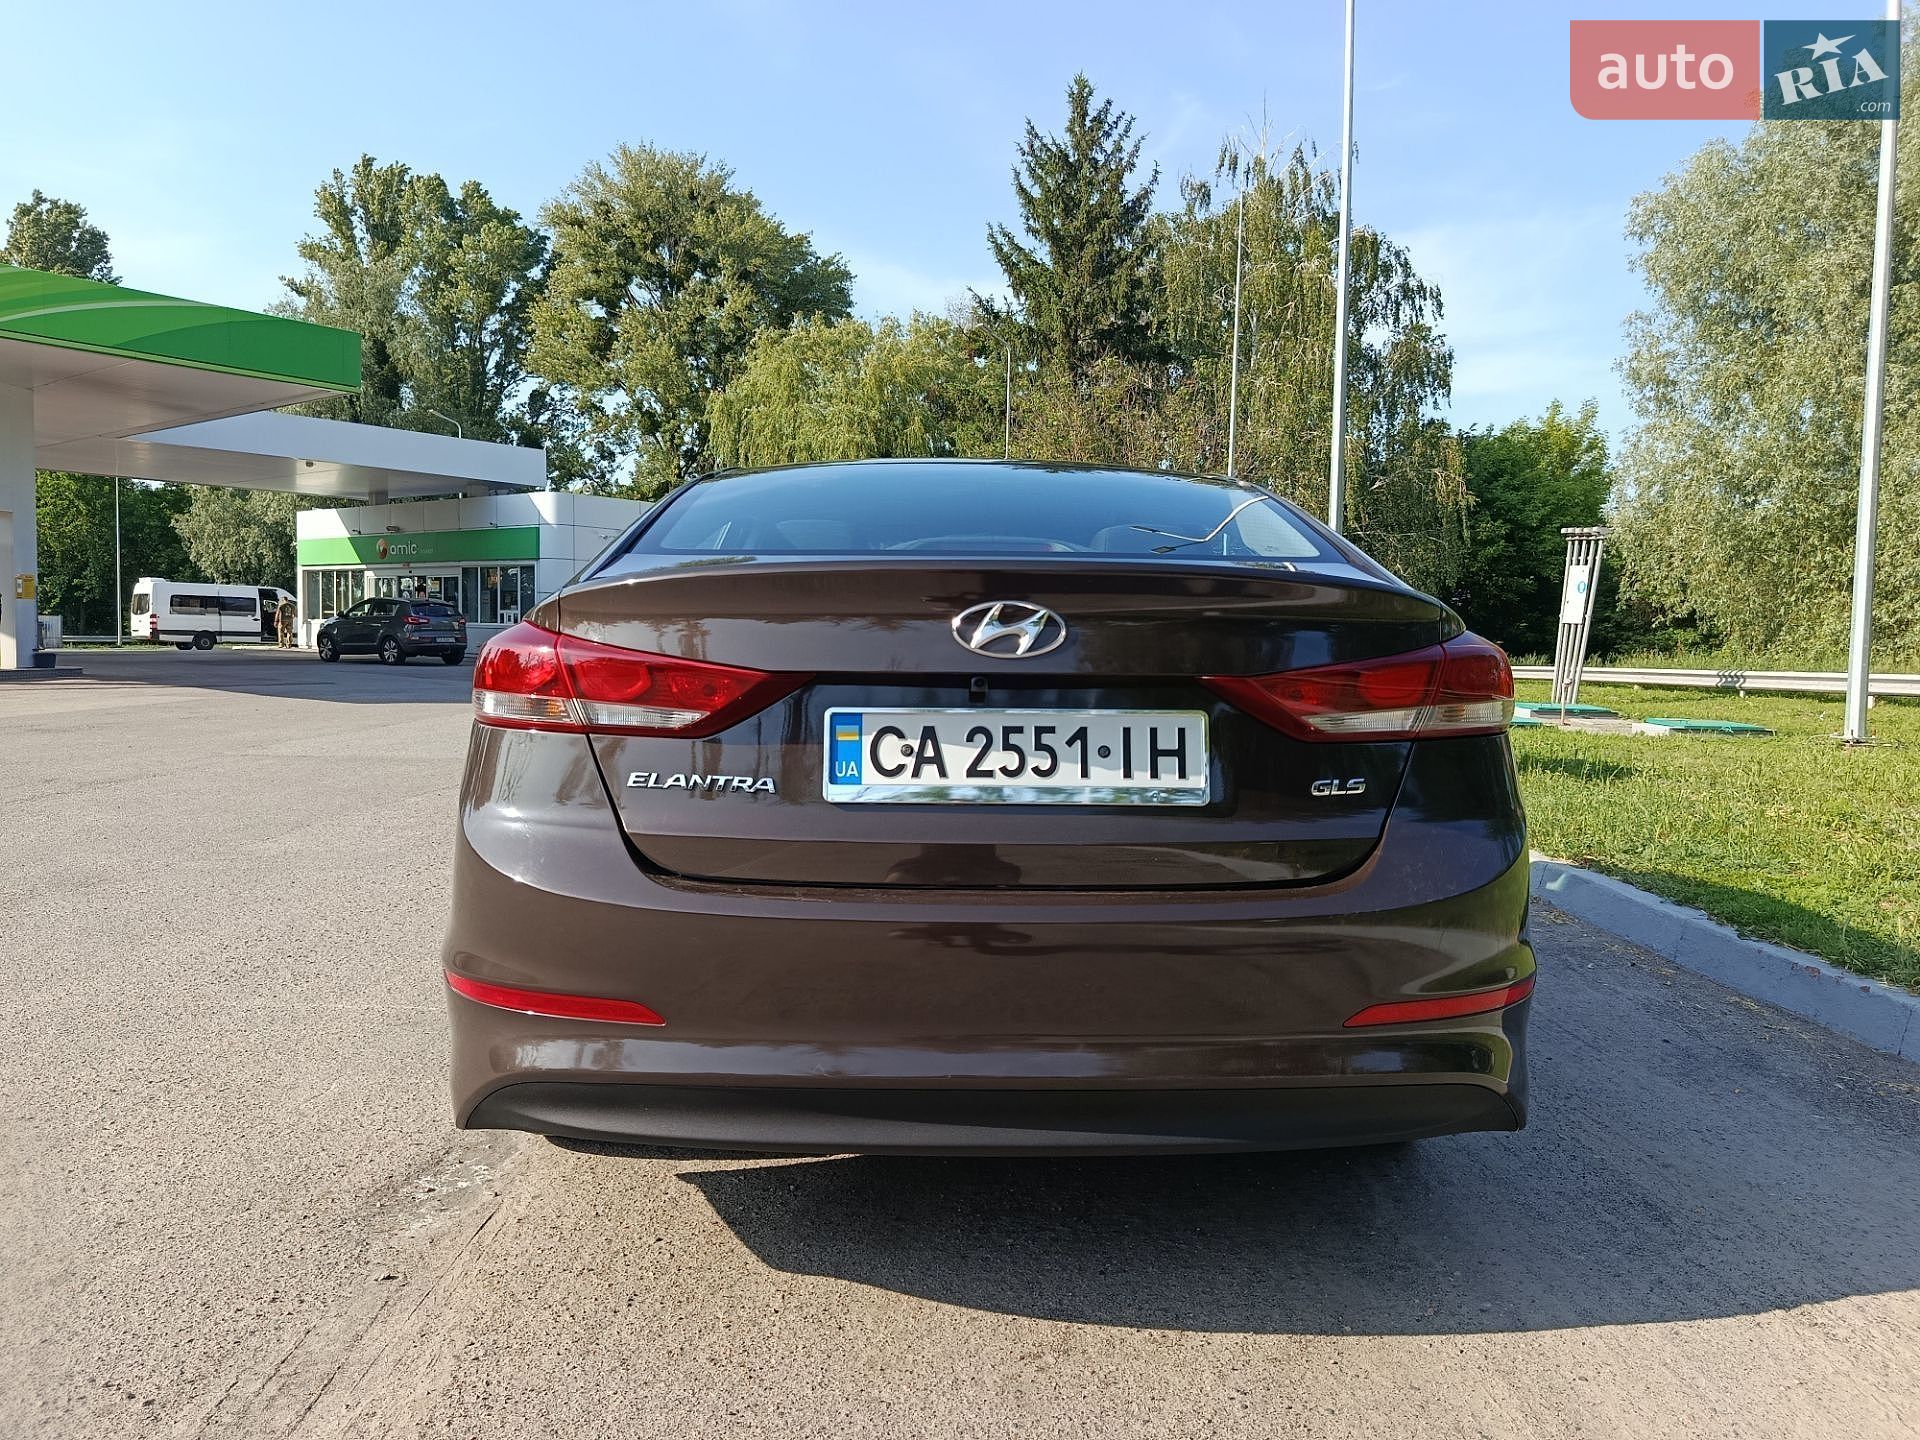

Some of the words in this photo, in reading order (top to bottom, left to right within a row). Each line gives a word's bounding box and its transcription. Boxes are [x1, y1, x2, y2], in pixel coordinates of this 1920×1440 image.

[389, 540, 417, 554] amic
[870, 725, 948, 778] CA
[965, 725, 1089, 779] 2551
[1122, 726, 1187, 780] IH
[835, 761, 859, 778] UA
[627, 772, 776, 794] ELANTRA
[1311, 778, 1366, 796] GLS
